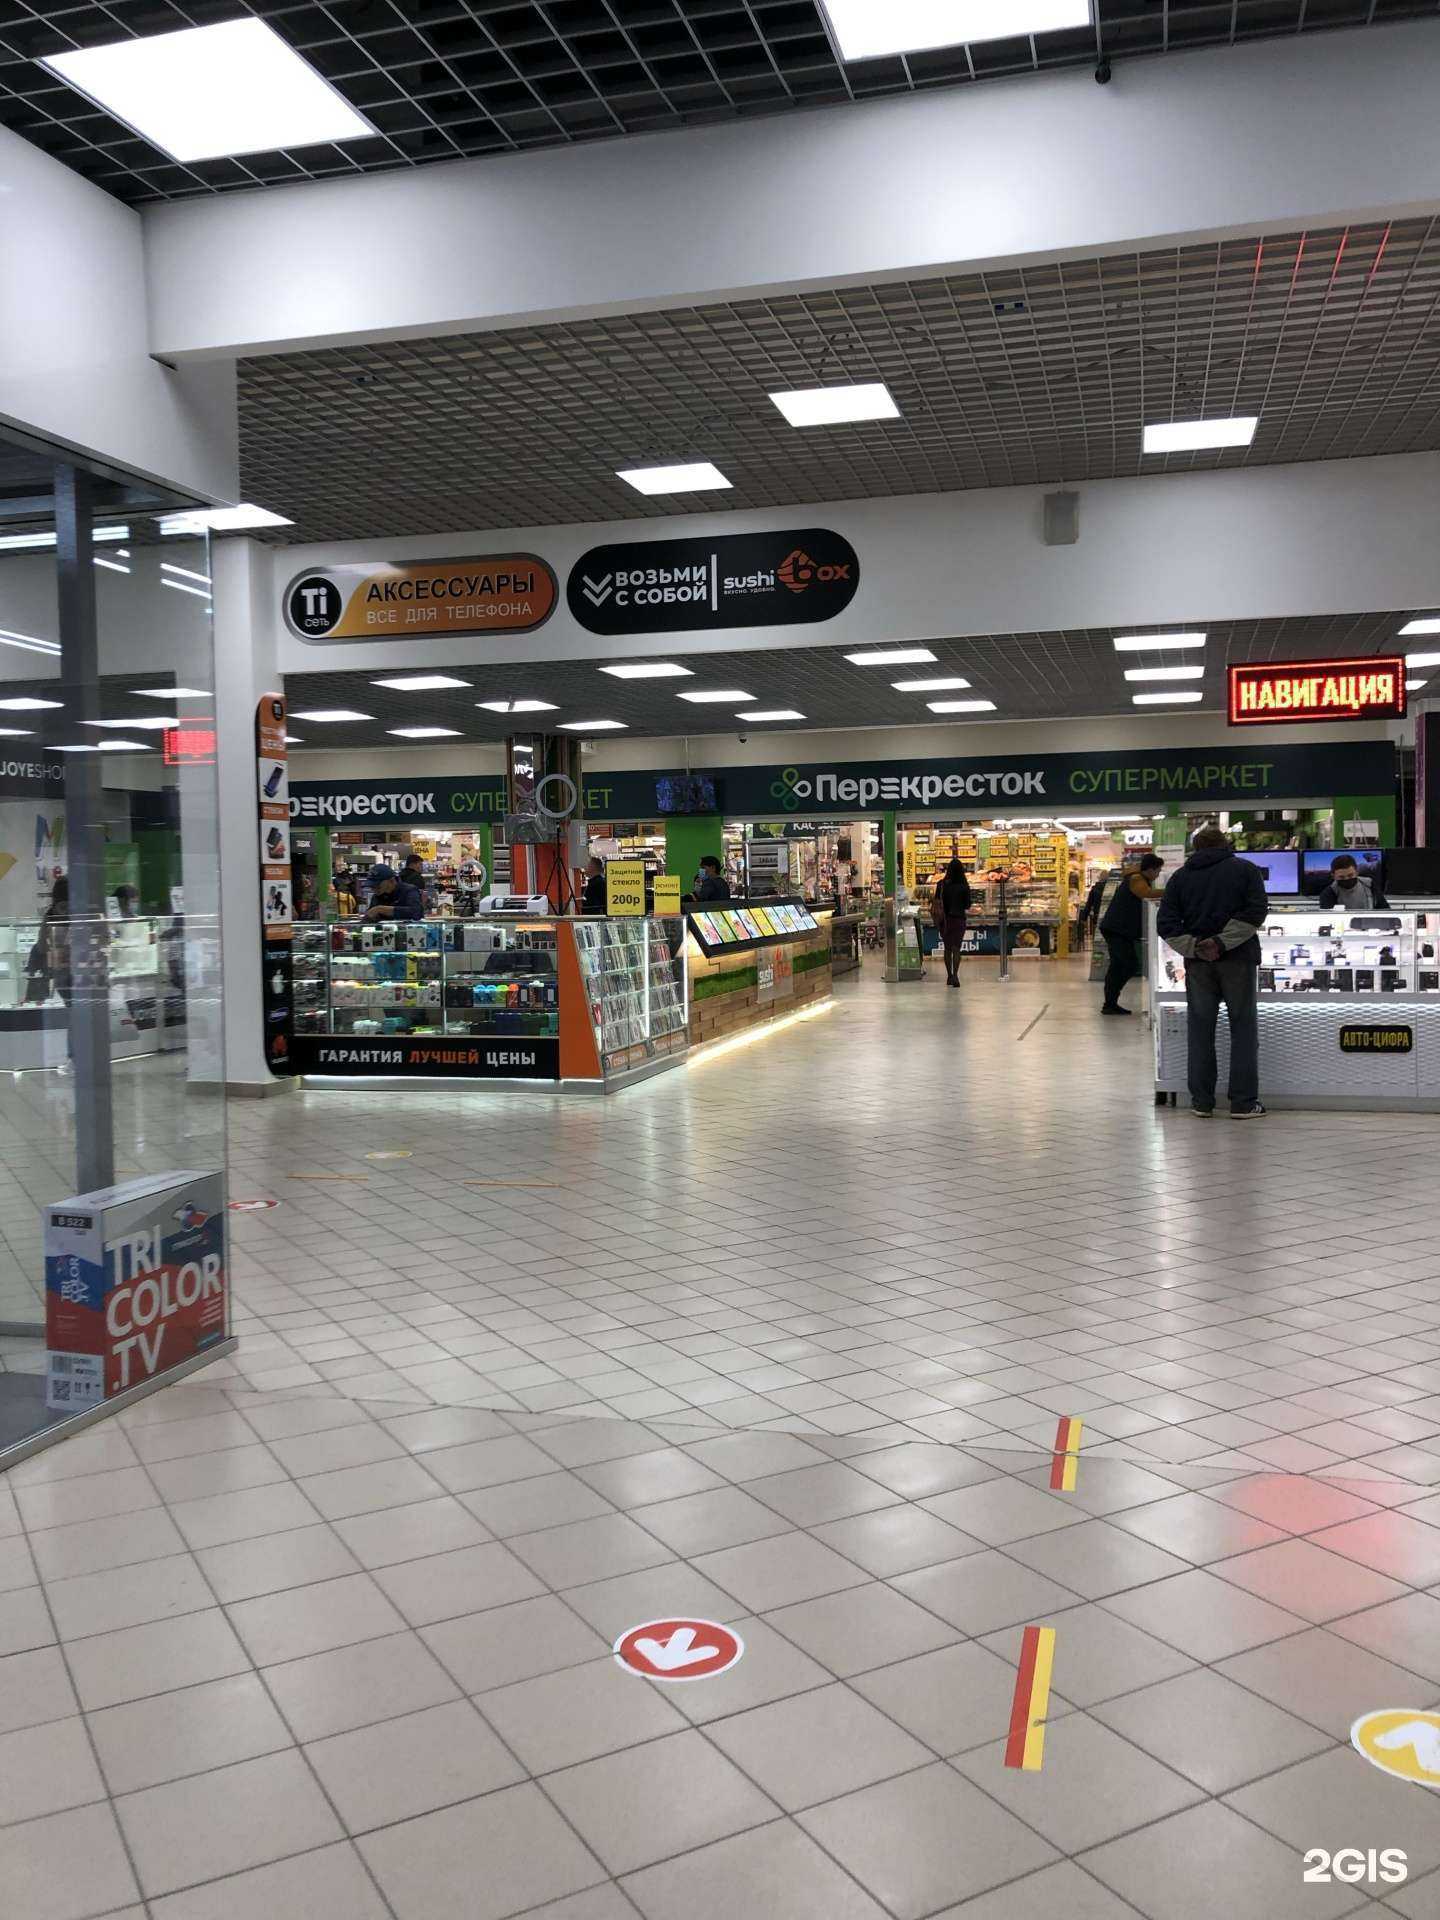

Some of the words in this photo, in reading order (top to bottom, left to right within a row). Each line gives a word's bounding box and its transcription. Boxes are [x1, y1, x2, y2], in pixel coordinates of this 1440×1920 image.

[366, 572, 535, 602] АКСЕССУАРЫ
[615, 565, 707, 587] ВОЗЬМИ
[723, 569, 775, 589] sushi
[301, 587, 328, 615] Ti
[615, 590, 629, 606] С
[633, 581, 707, 605] СОБОЙ
[367, 608, 397, 624] ВСЕ
[405, 607, 438, 623] ДЛЯ
[447, 601, 533, 620] ТЕЛЕФОНА
[1240, 673, 1394, 710] НАВИГАЦИЯ
[816, 770, 1046, 807] Перекресток
[1070, 764, 1274, 793] СУПЕРМАРКЕТ
[611, 894, 641, 906] 200р
[1343, 1031, 1410, 1048] АВТО-ЦИФРА
[319, 1049, 403, 1063] ГАРАНТИЯ
[409, 1048, 480, 1064] ЛУЧШЕЙ
[486, 1051, 536, 1067] ЦЕНЫ
[104, 1225, 163, 1286] TRI
[106, 1252, 223, 1338] COLOR
[112, 1323, 166, 1391] .TV
